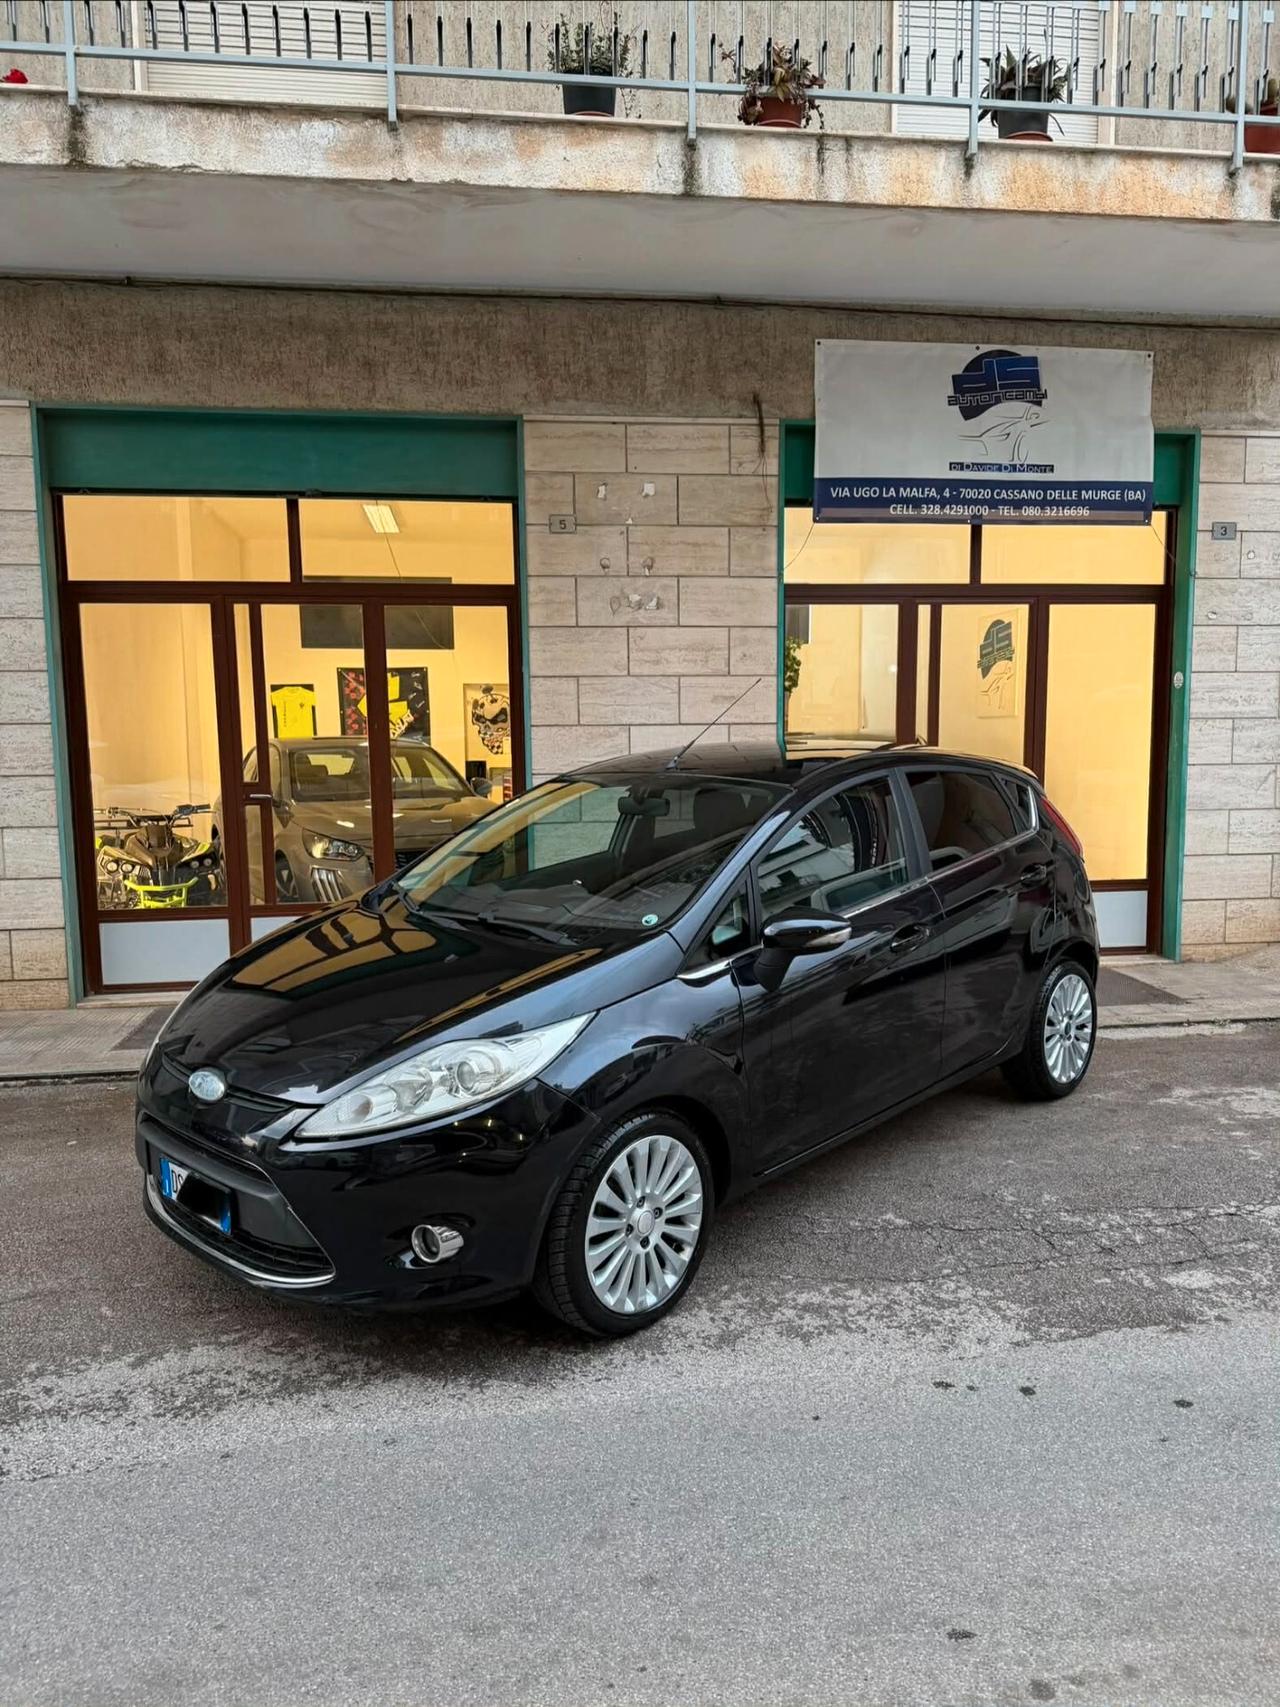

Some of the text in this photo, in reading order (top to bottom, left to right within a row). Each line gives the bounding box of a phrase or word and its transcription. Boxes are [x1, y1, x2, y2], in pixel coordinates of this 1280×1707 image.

[1016, 463, 1054, 474] MONTE
[830, 487, 850, 498] VIA
[853, 487, 879, 498] UGO
[882, 487, 896, 498] LA
[900, 487, 940, 500] MALFA,
[943, 488, 950, 498] 4
[960, 488, 991, 499] 70020
[993, 489, 1044, 500] CASSANO
[1047, 489, 1078, 500] DELLE
[1081, 490, 1121, 501] MURGE
[1124, 489, 1146, 502] (BA)
[889, 504, 917, 515] CELL.
[920, 504, 989, 516] 328.4291000
[998, 506, 1019, 516] TEL.
[1022, 506, 1090, 517] 080.3216696
[559, 519, 566, 530] 5
[1220, 526, 1227, 536] 3
